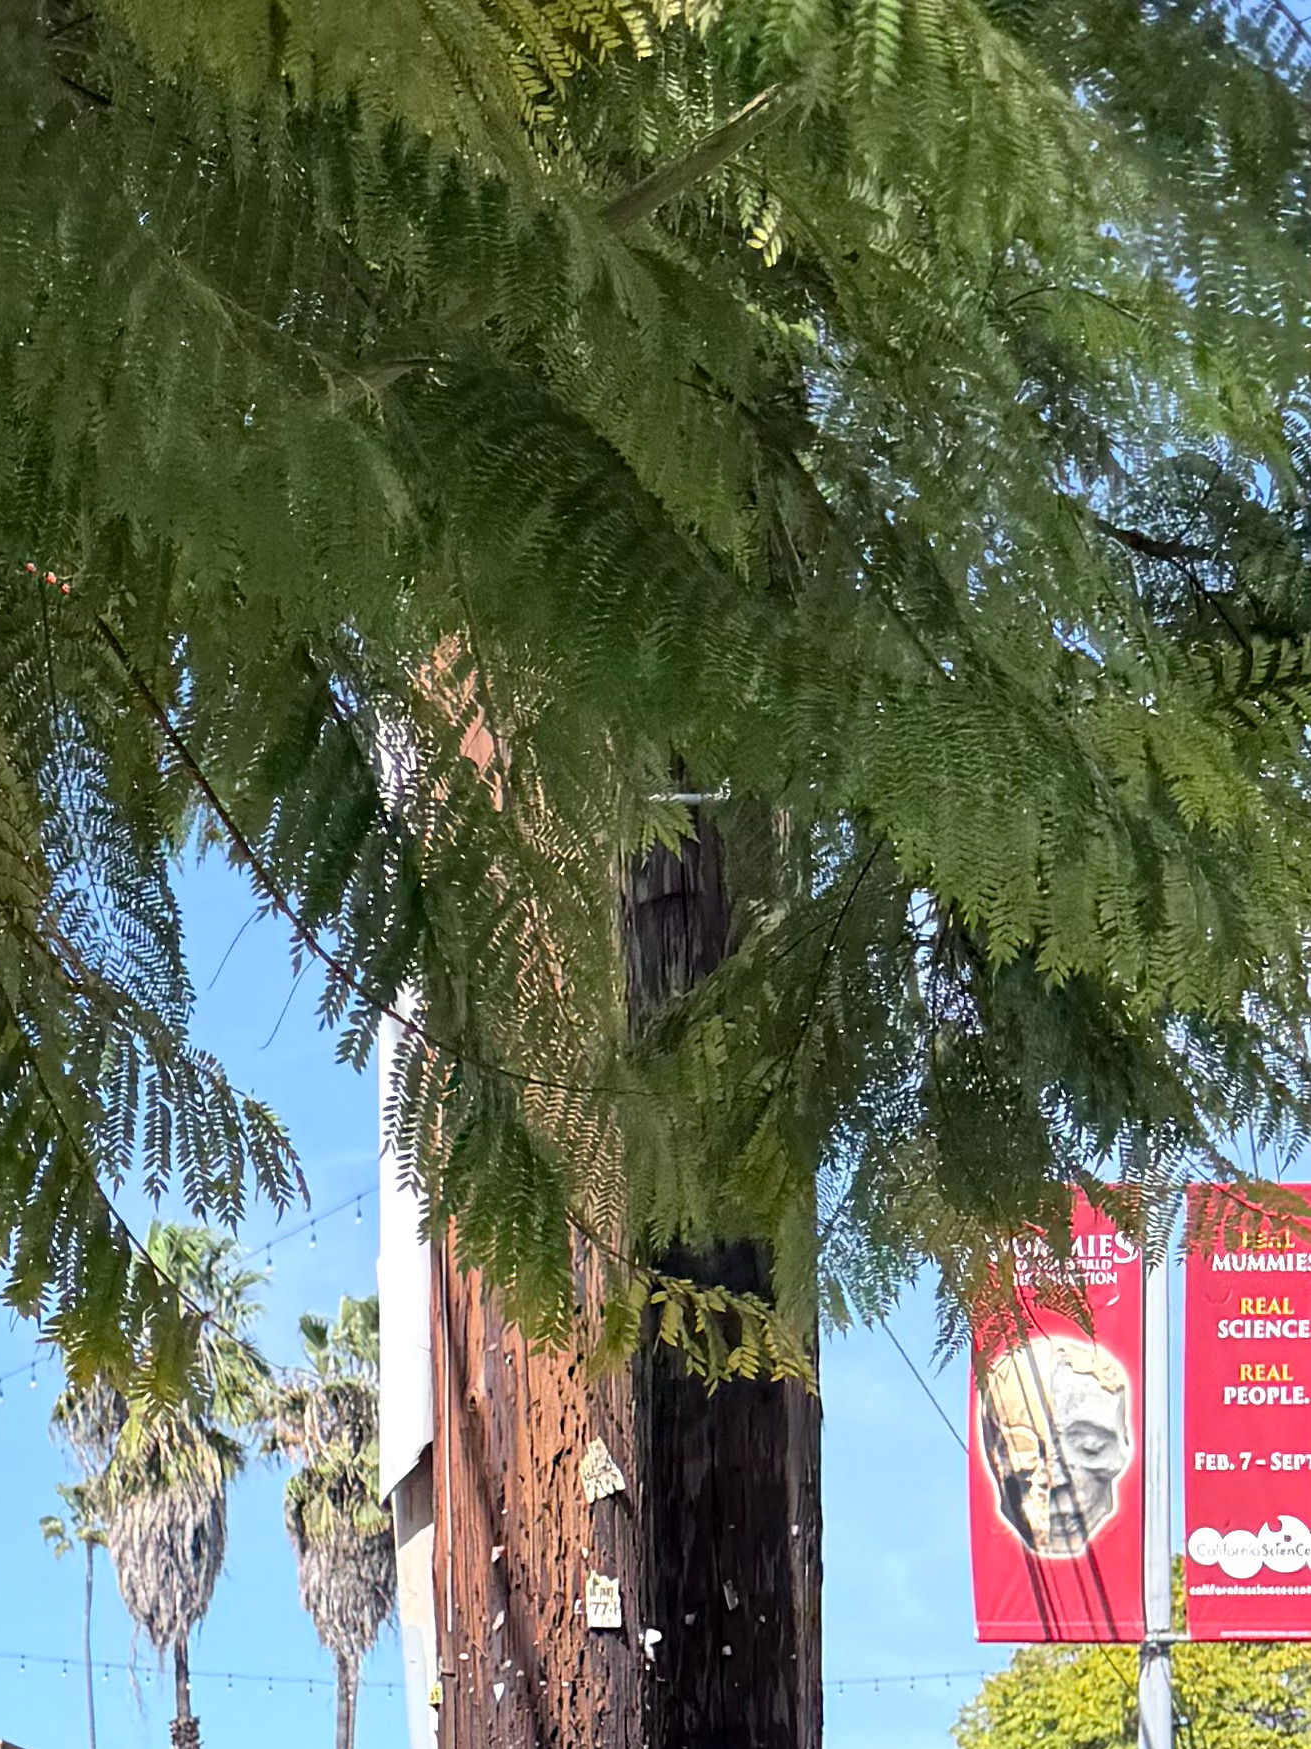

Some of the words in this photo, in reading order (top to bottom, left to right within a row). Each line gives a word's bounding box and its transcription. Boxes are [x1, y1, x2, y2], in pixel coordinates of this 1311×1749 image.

[1240, 1296, 1295, 1316] REAL
[1239, 1363, 1294, 1382] REAL
[1223, 1386, 1311, 1405] PEOPLE.
[1194, 1451, 1236, 1471] FEB.
[1239, 1452, 1252, 1471] 7
